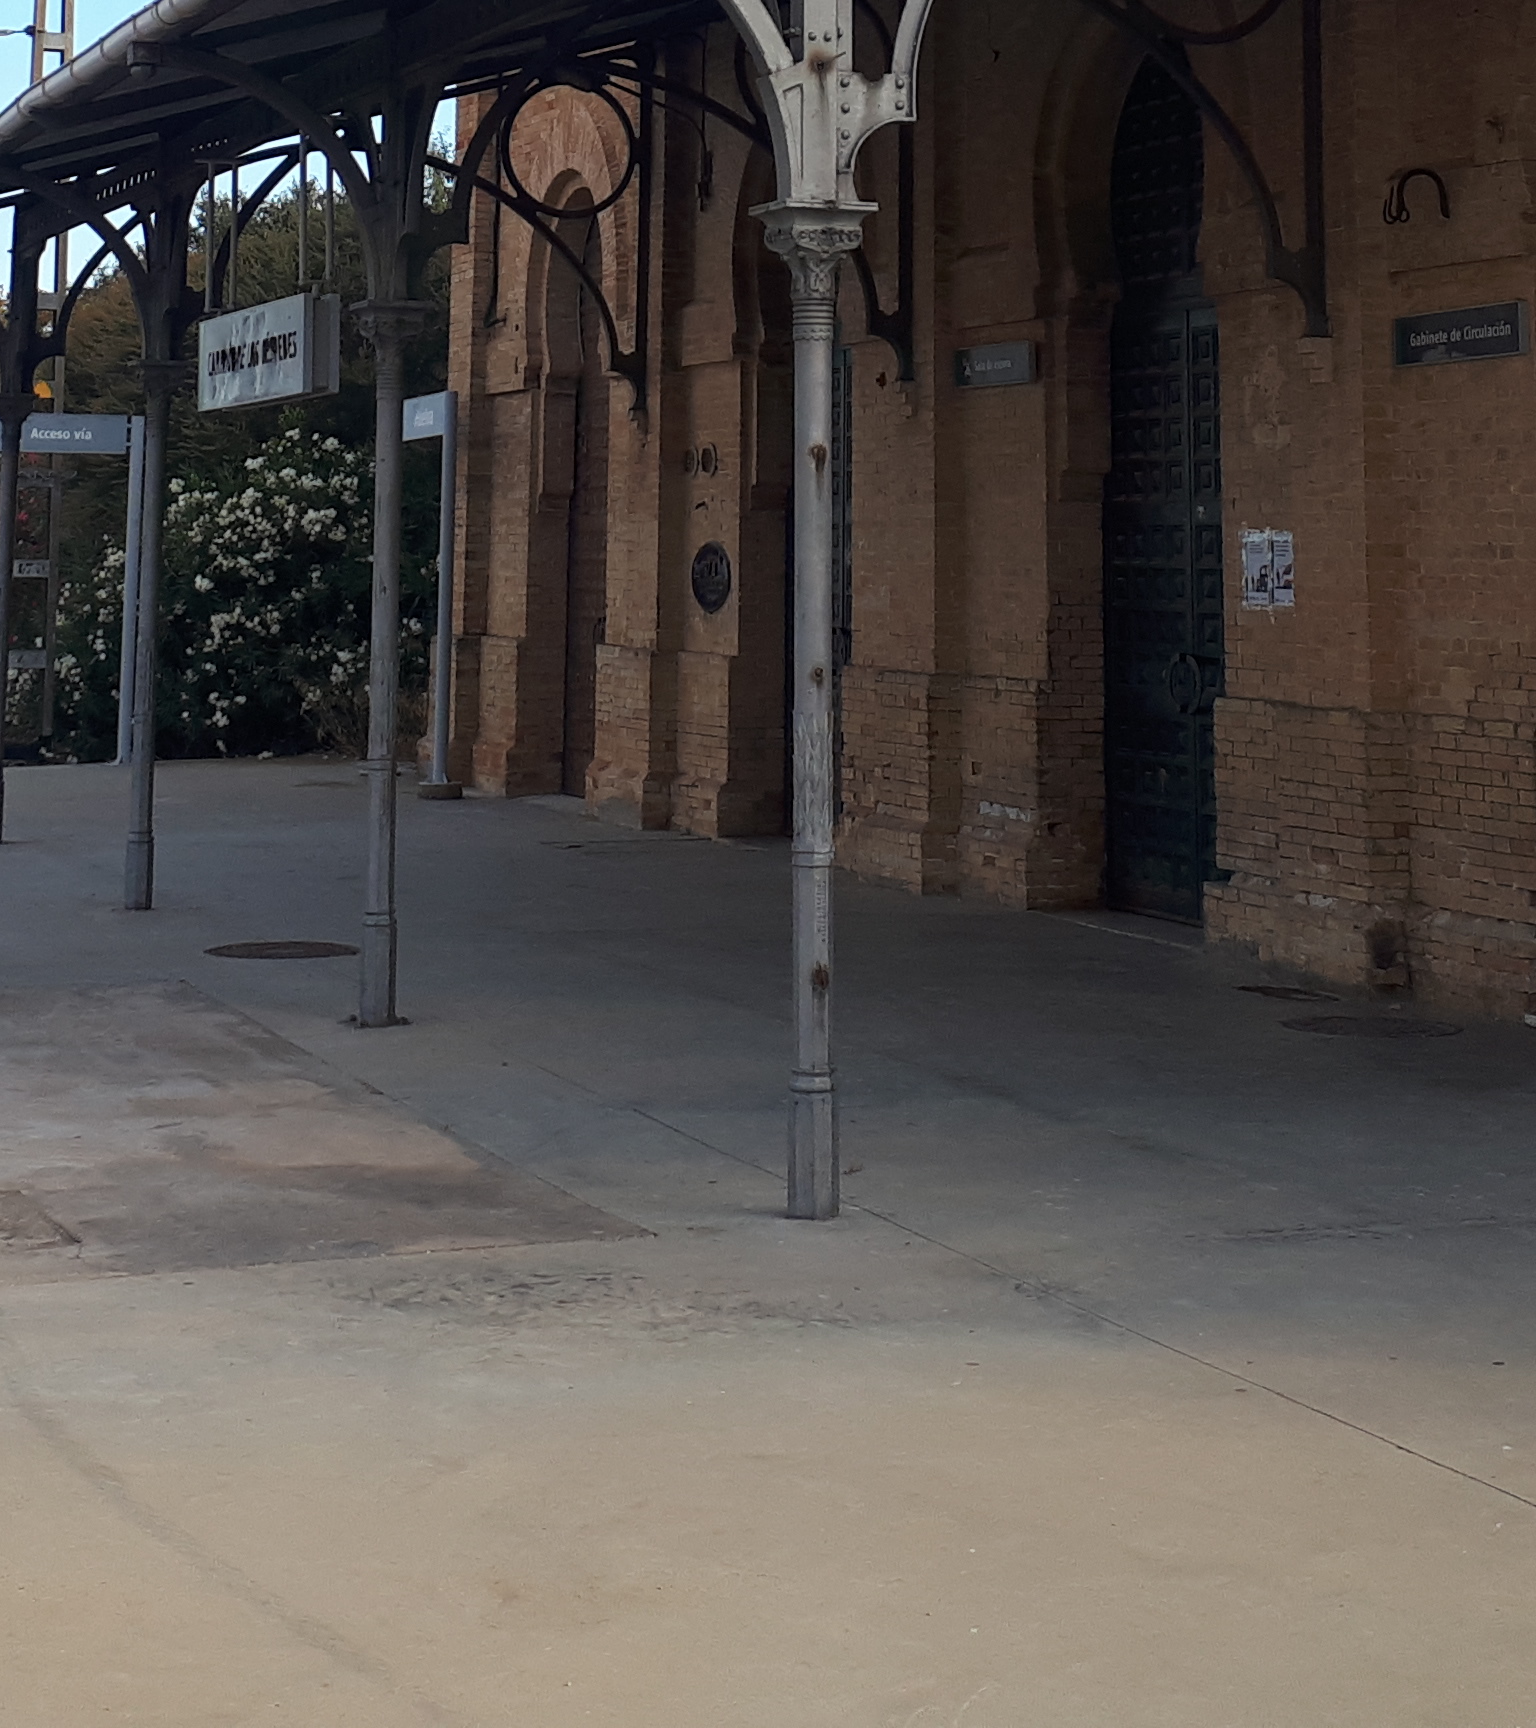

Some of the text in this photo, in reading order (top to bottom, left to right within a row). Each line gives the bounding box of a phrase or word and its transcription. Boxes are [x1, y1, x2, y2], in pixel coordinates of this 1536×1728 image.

[1410, 319, 1512, 347] Gabinete de Circulación
[30, 426, 92, 440] Acceso vía
